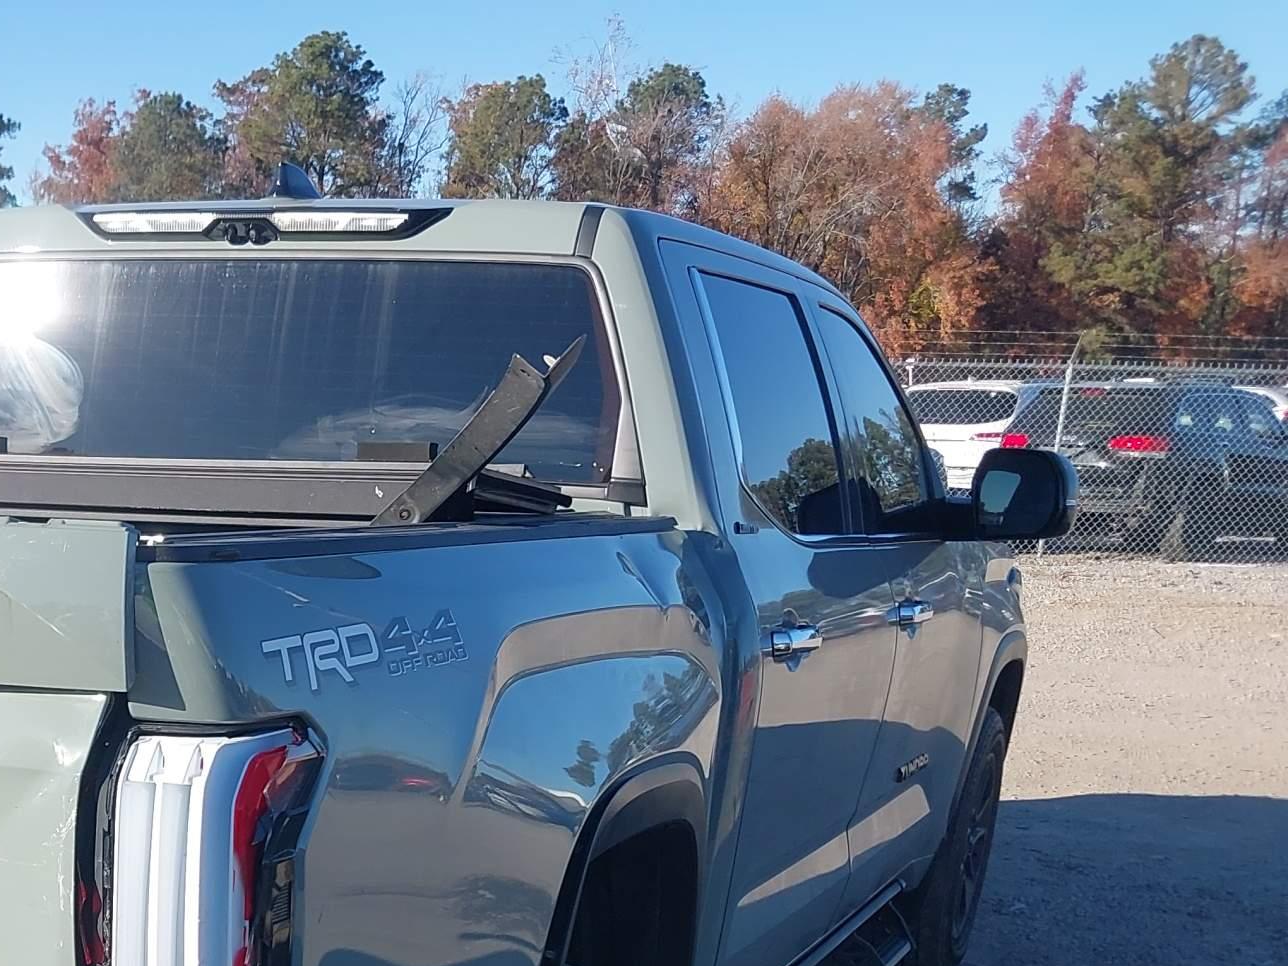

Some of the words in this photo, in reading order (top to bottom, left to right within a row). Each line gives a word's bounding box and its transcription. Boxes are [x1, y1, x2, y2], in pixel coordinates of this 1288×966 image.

[260, 622, 380, 692] TRD
[384, 609, 464, 656] 4x4
[387, 661, 425, 677] OFF
[426, 648, 470, 668] ROAD
